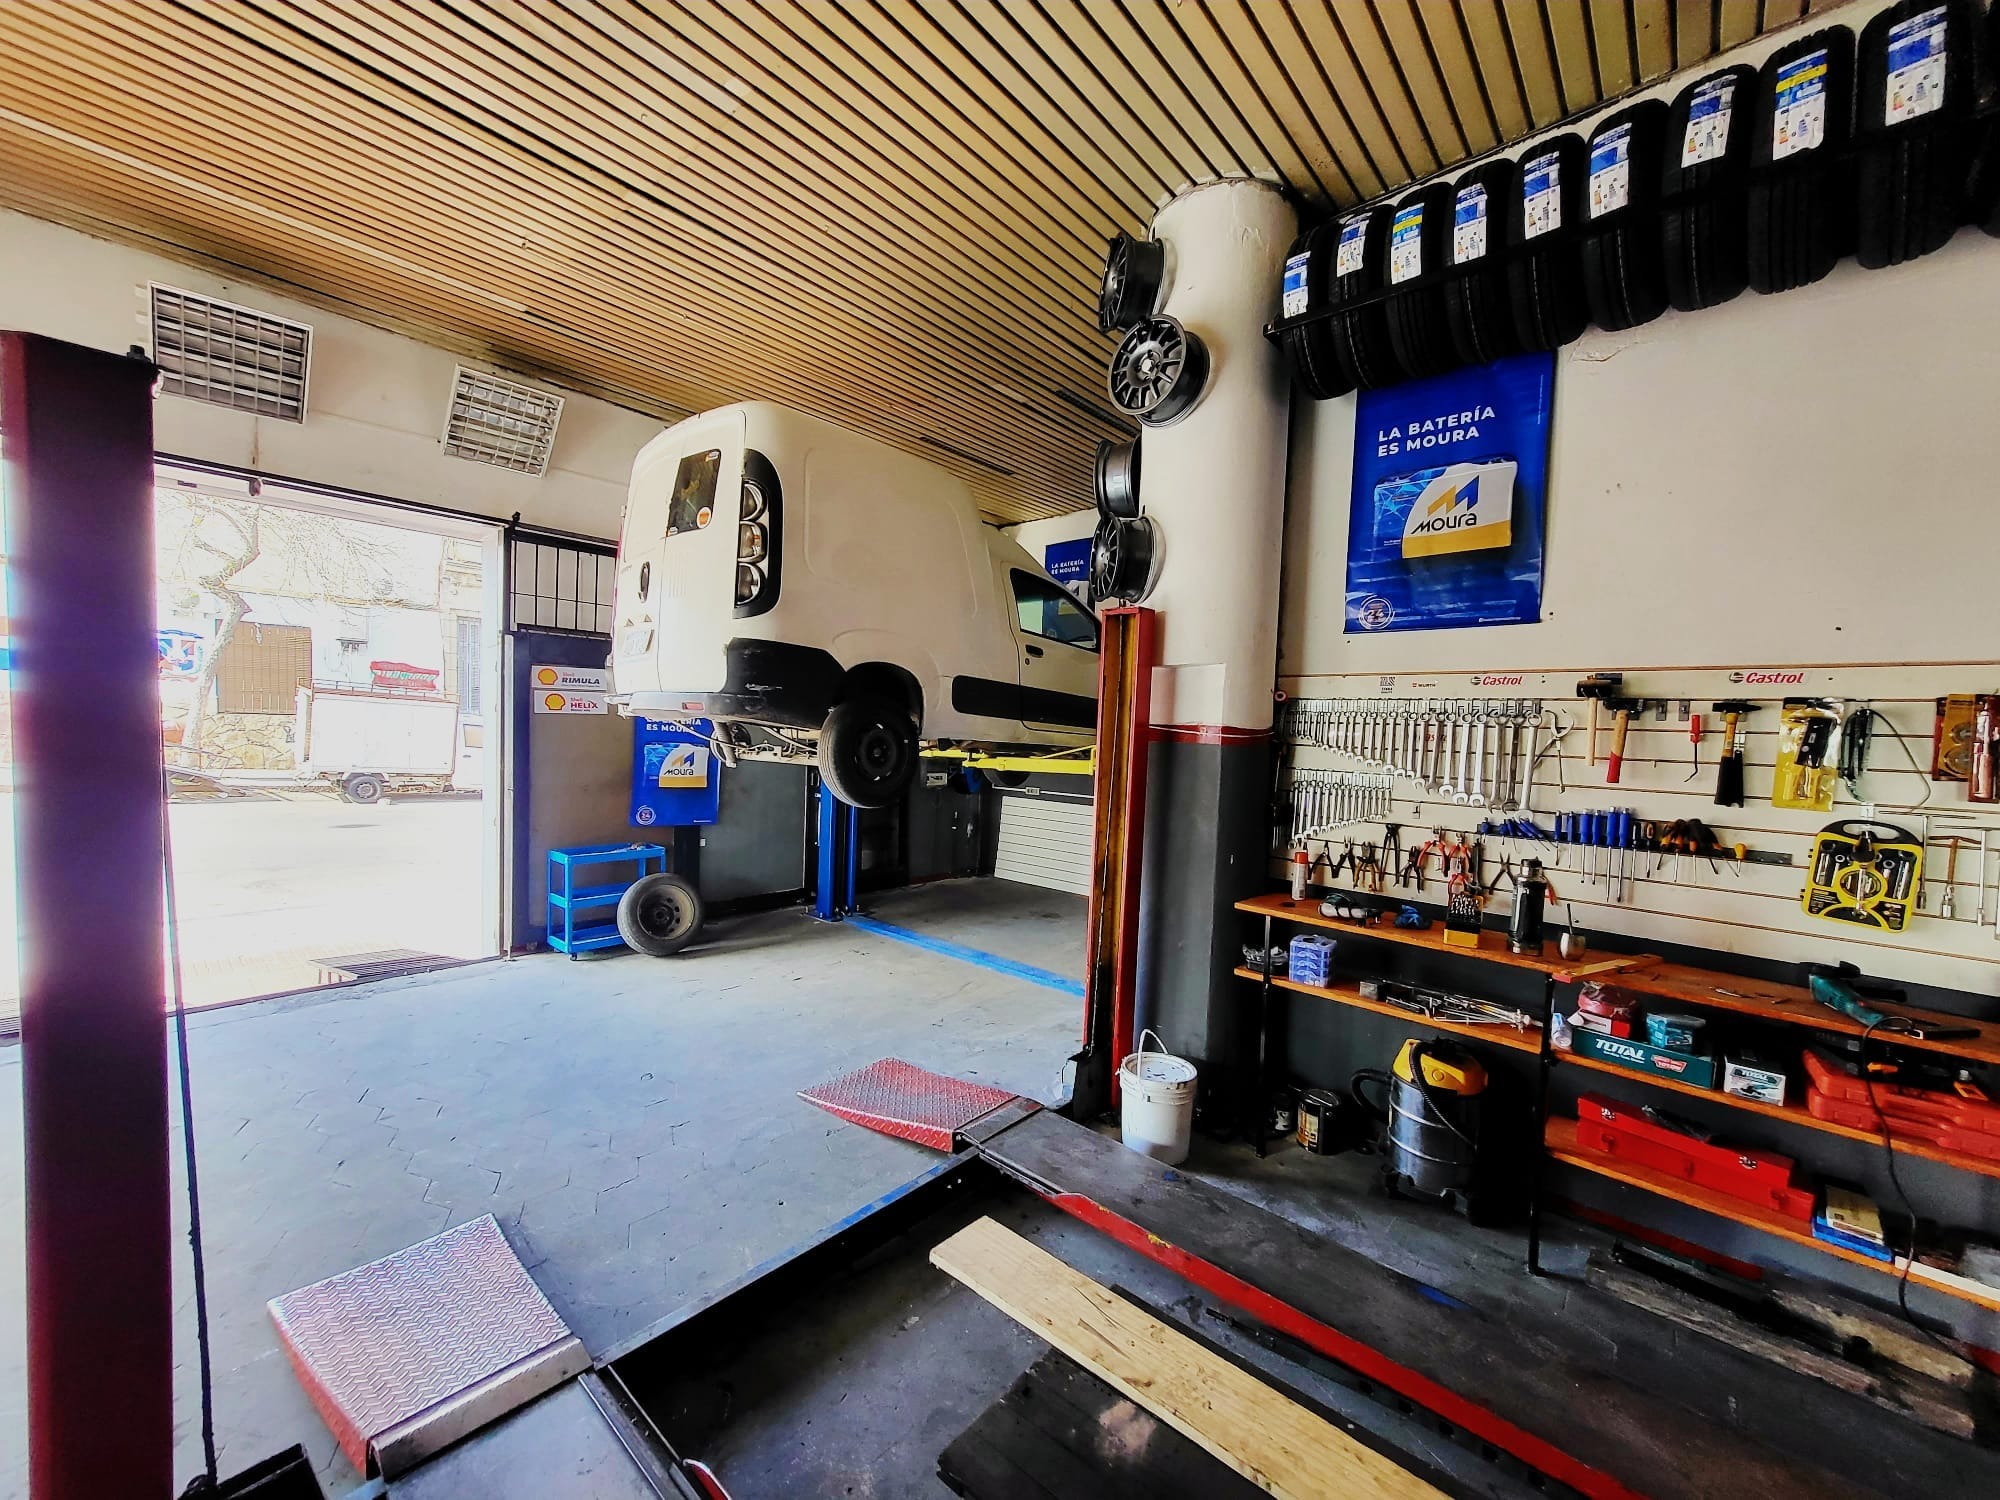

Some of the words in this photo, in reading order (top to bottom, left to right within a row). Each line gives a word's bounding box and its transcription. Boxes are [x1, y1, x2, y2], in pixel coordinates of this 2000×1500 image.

[1378, 427, 1402, 442] LA
[1408, 405, 1496, 436] BATERÍA
[1377, 442, 1400, 458] ES
[1406, 426, 1480, 452] MOURA
[561, 677, 600, 685] RIMULA
[1483, 675, 1523, 686] Castrol
[1745, 672, 1804, 684] Castrol
[570, 701, 599, 709] HELIX
[646, 723, 659, 731] ES
[1596, 1039, 1646, 1061] TOTAL
